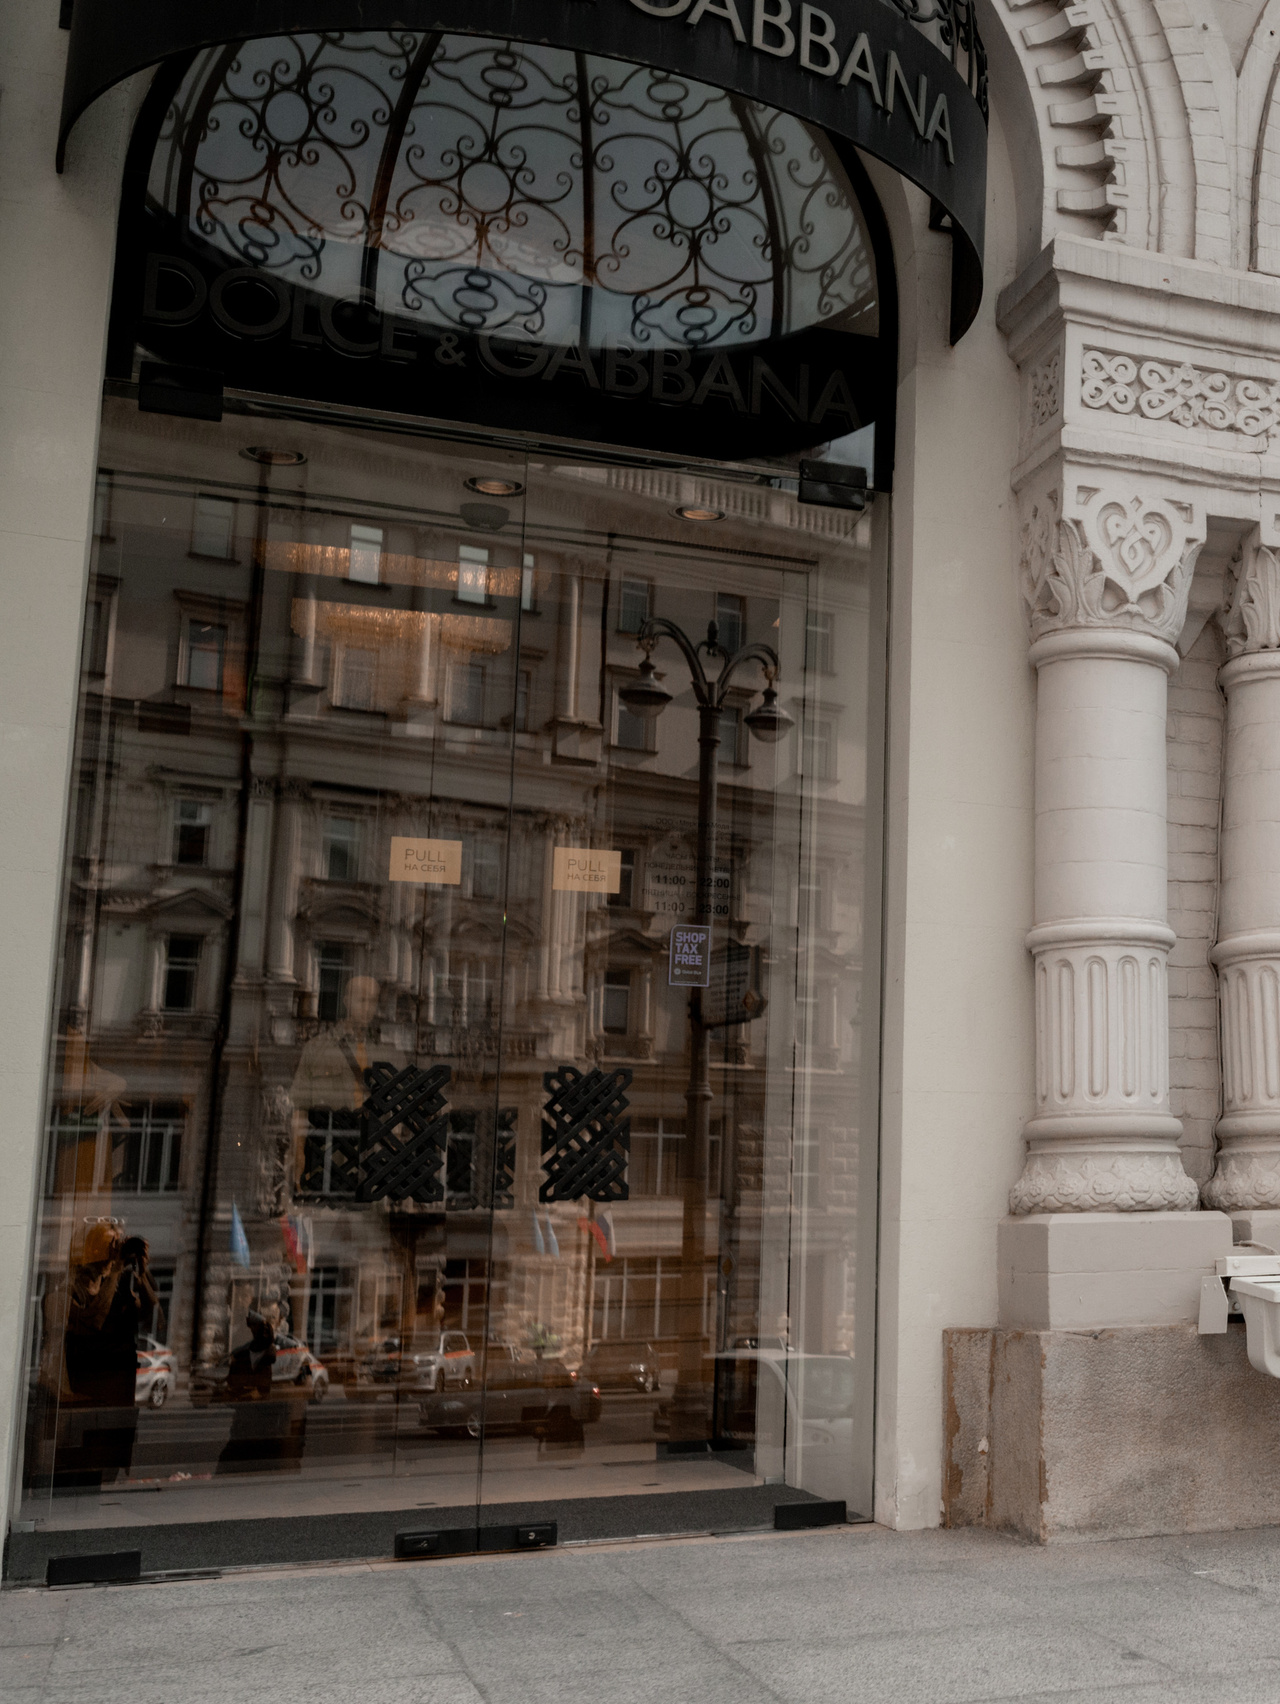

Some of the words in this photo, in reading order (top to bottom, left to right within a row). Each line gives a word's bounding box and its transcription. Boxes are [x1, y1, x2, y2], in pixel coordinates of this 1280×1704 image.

[144, 252, 418, 363] DOLCE
[478, 324, 863, 428] GABBANA
[404, 848, 446, 863] PULL
[404, 862, 418, 871] НА
[420, 863, 446, 873] СЕБЯ
[567, 858, 606, 873] PULL
[567, 872, 581, 881] НА
[582, 873, 606, 882] СЕБЯ
[655, 874, 686, 885] 11:00
[699, 877, 730, 889] 22:00
[655, 901, 685, 912] 11:00
[699, 904, 729, 915] 23:00
[675, 931, 706, 943] SHOP
[675, 943, 698, 954] TAX
[674, 954, 702, 966] FREE
